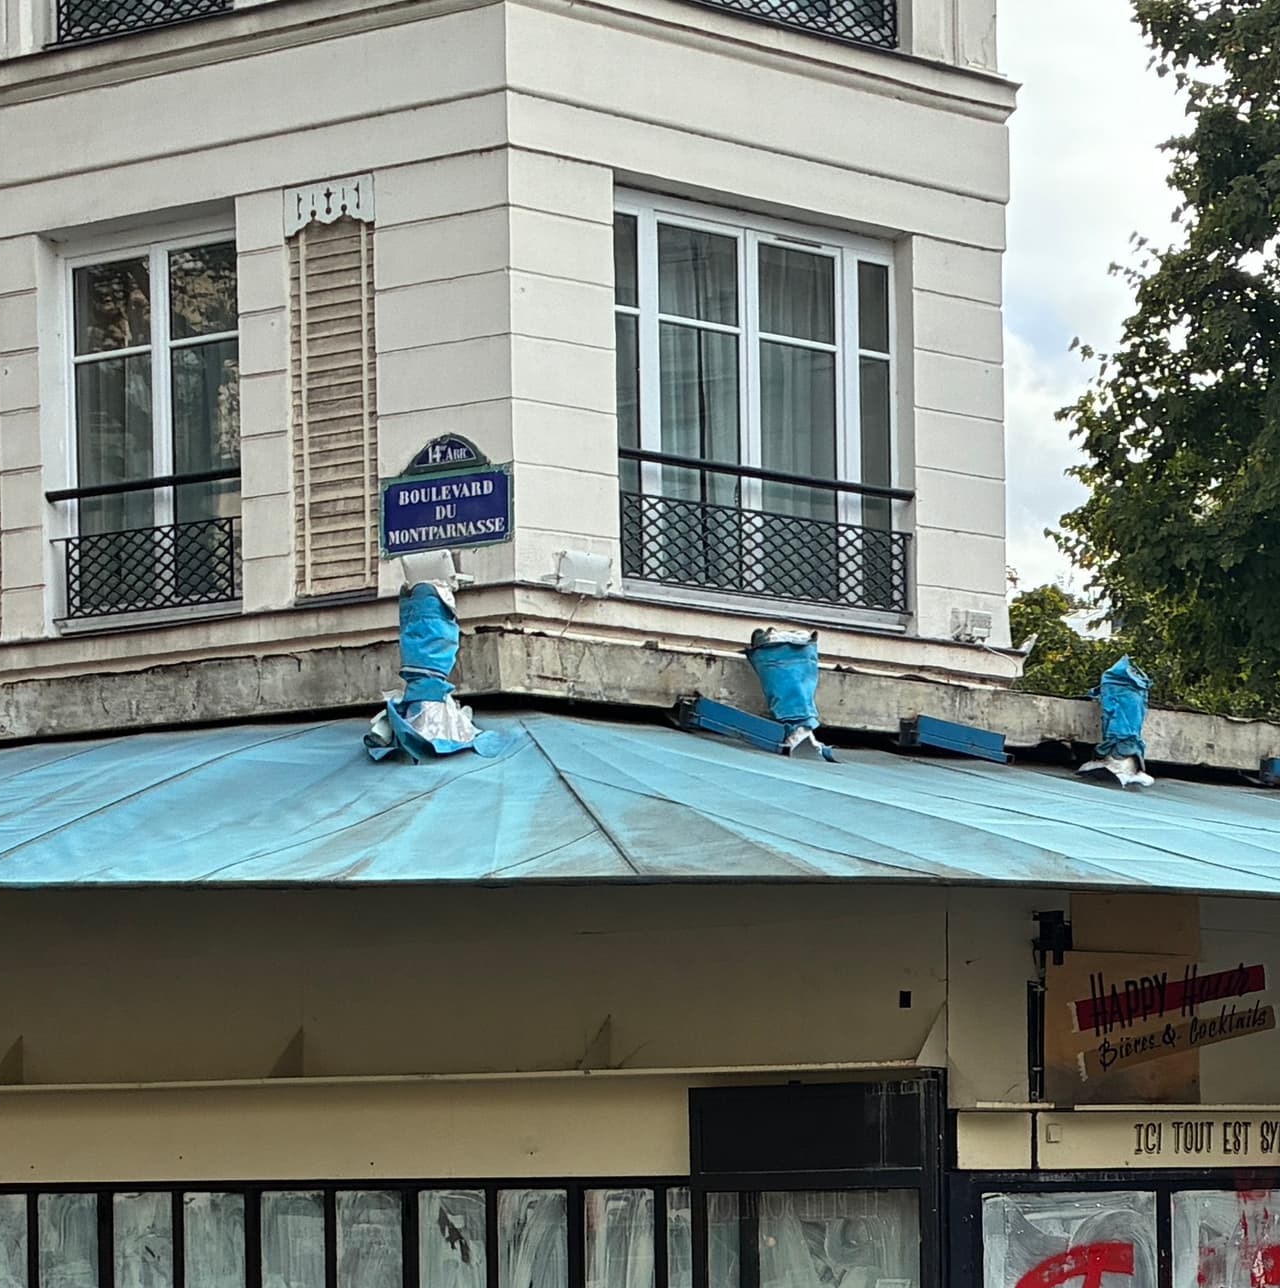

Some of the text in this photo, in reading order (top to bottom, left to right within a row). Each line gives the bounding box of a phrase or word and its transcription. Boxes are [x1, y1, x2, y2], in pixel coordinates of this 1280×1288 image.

[399, 480, 494, 506] BOULEVARD
[435, 504, 456, 520] DU
[388, 517, 505, 546] MONTPARNASSE
[1089, 971, 1168, 1037] HAPPY
[1162, 1023, 1176, 1048] &
[1189, 1000, 1267, 1045] Cocktails
[1133, 1122, 1162, 1155] ICI
[1171, 1121, 1214, 1154] TOUT
[1223, 1121, 1252, 1153] EST
